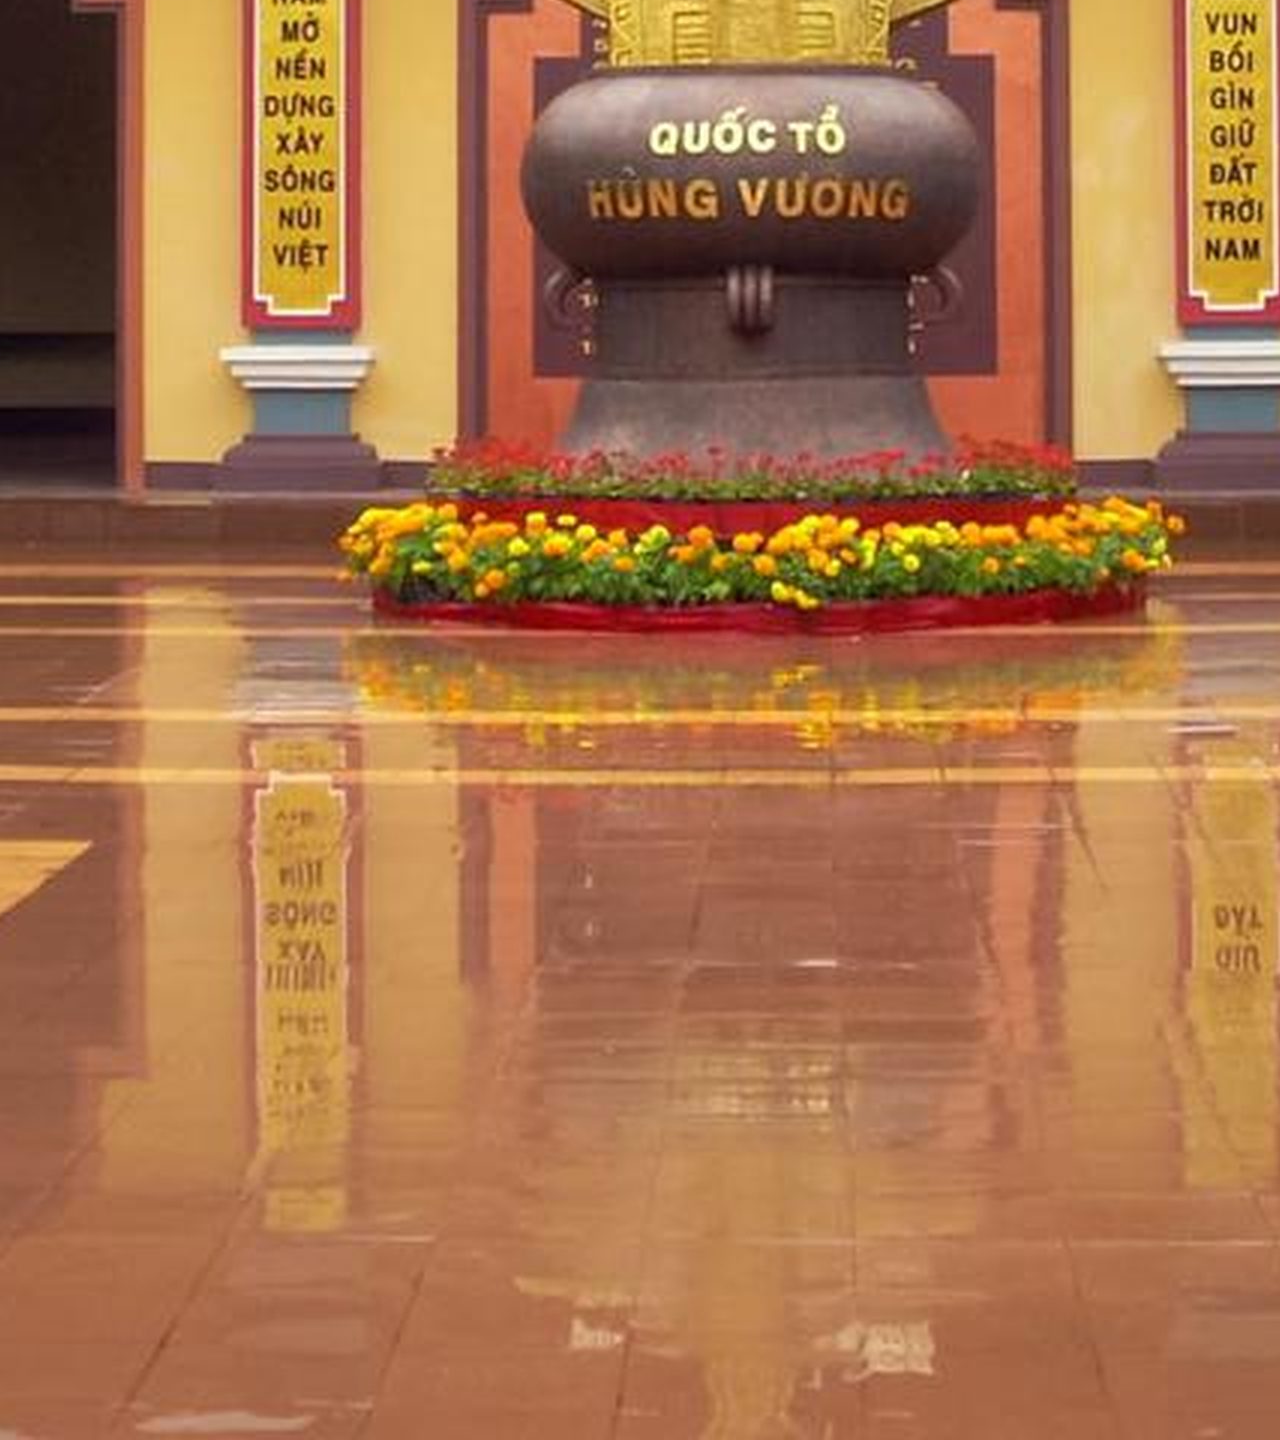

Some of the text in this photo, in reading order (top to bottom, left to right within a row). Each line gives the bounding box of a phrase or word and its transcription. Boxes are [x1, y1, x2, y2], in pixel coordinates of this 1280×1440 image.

[1205, 13, 1257, 35] VUN
[264, 93, 335, 123] DỰNG
[1210, 81, 1254, 110] GÌN
[276, 126, 324, 155] XÂY
[649, 100, 846, 156] QUỐC TỔ
[264, 165, 335, 192] SÔNG
[1209, 152, 1257, 185] ĐẤT
[588, 166, 912, 220] HÙNG VƯƠNG
[278, 200, 322, 230] NÚI
[273, 239, 329, 273] VIỆT
[1205, 239, 1261, 260] NAM
